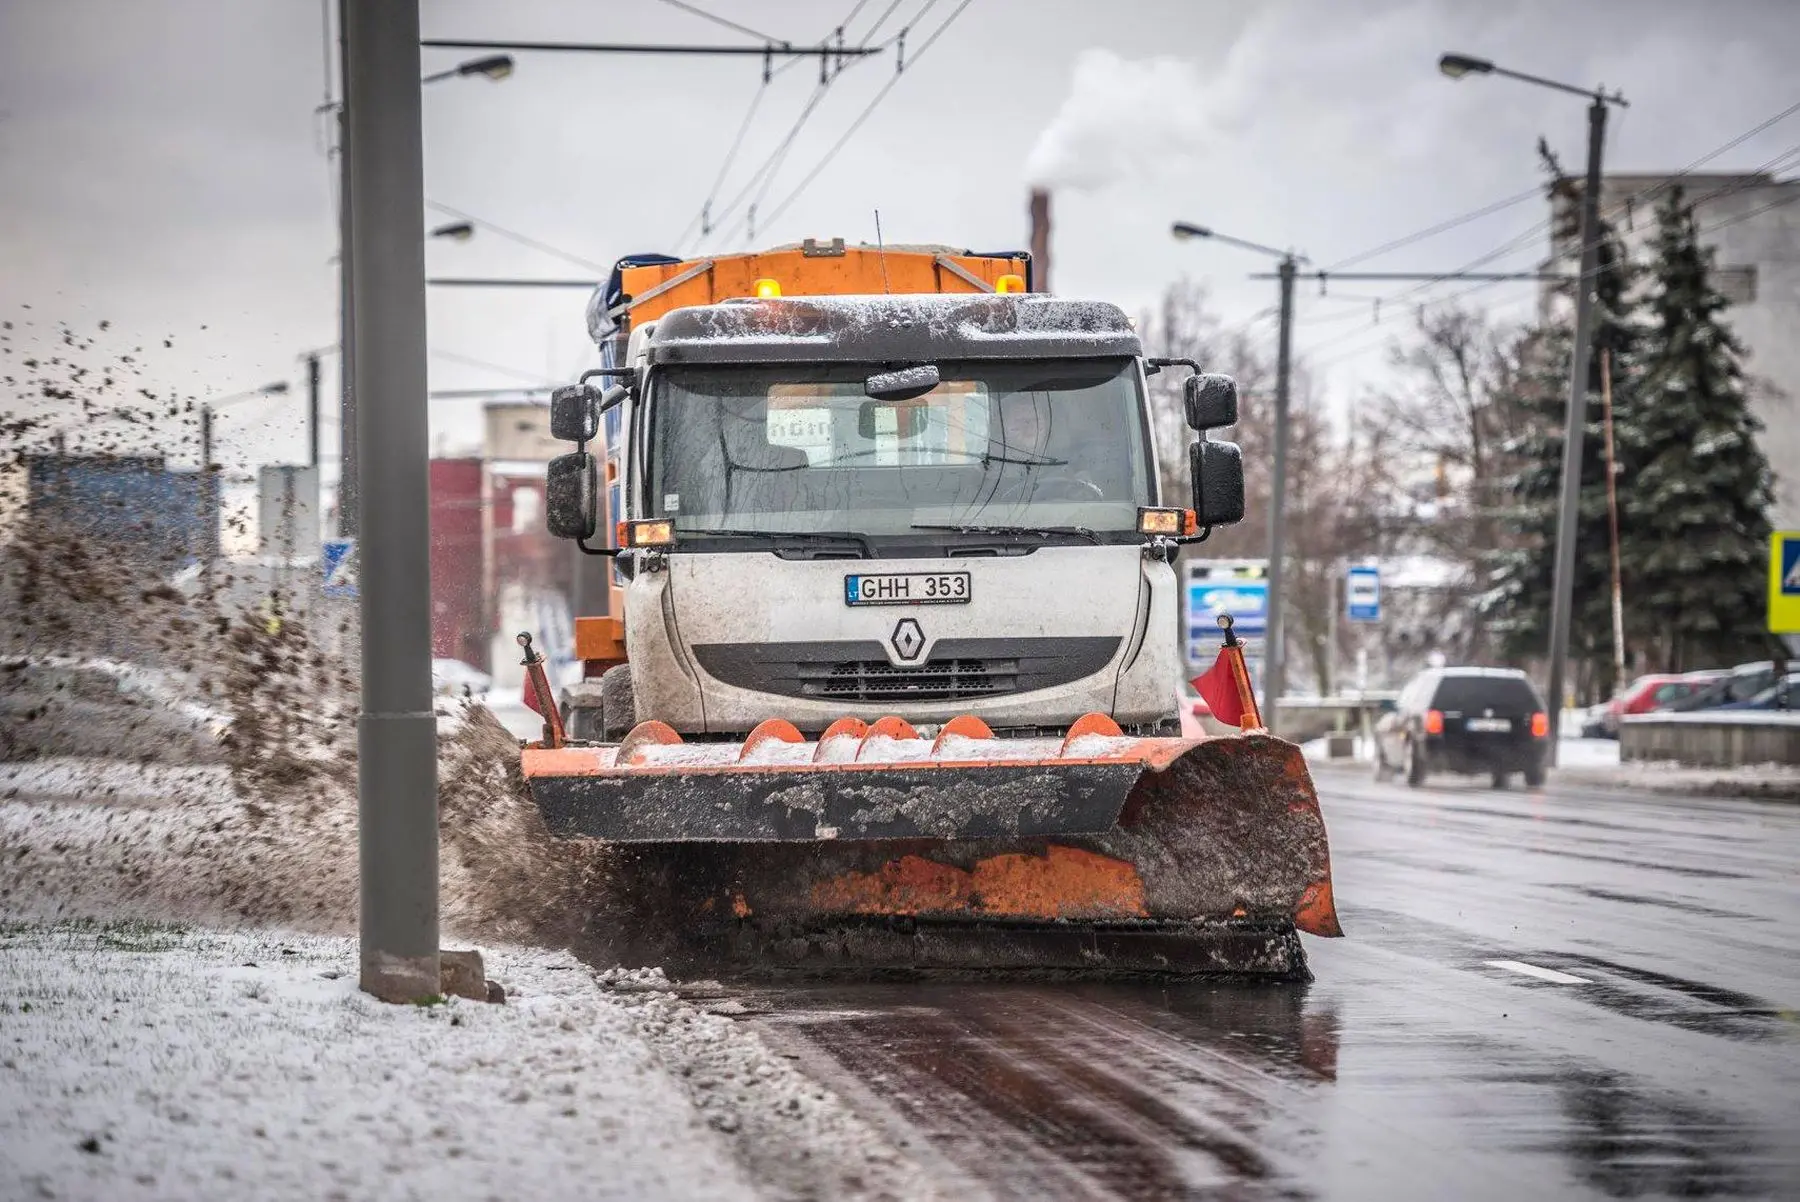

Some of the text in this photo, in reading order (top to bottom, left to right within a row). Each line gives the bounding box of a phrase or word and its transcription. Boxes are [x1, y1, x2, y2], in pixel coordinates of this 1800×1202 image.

[848, 590, 858, 598] LT
[861, 576, 965, 598] GHH 353
